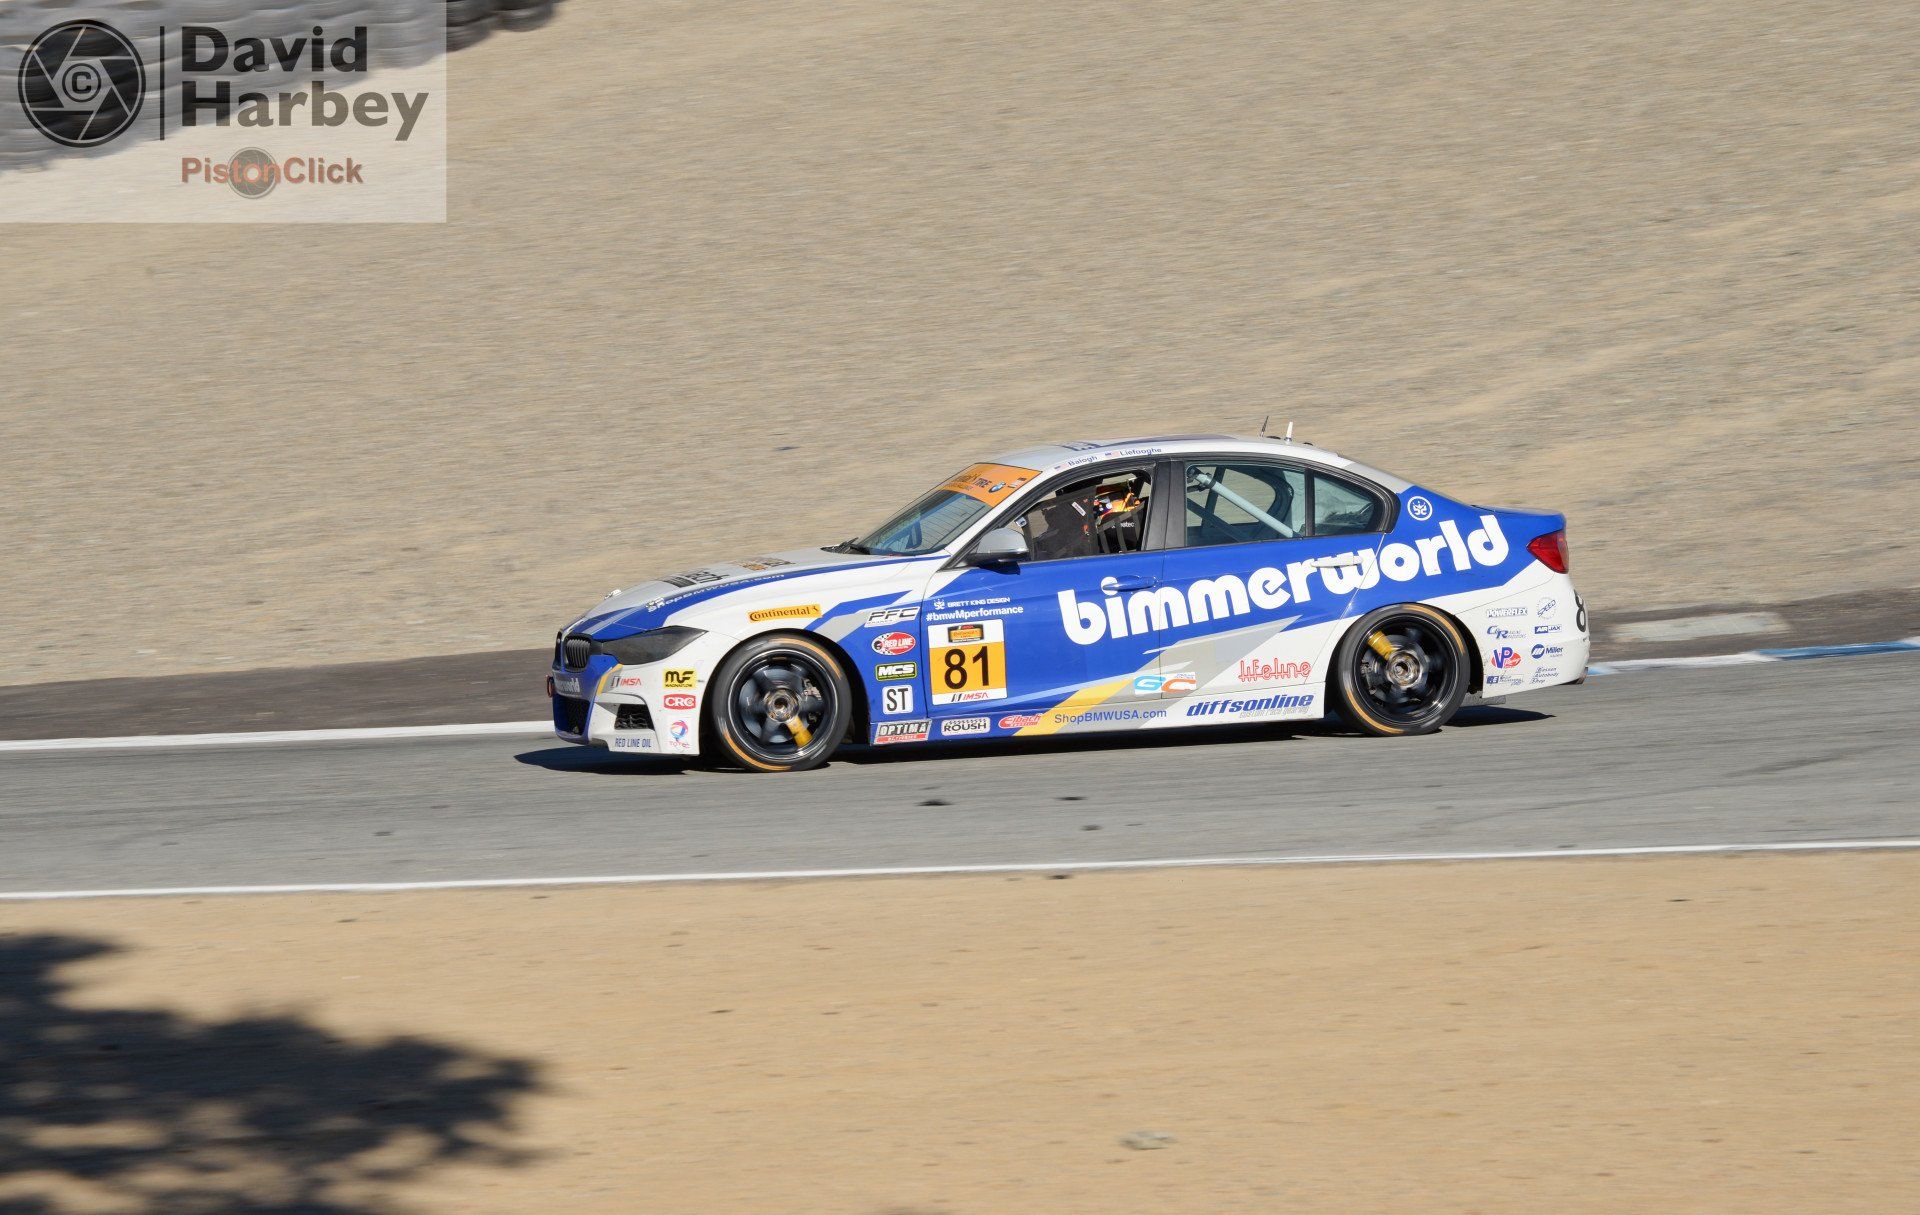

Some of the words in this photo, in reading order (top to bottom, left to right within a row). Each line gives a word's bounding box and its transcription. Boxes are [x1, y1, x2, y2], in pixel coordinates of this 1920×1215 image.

[1068, 456, 1098, 467] Balogh
[1058, 515, 1510, 645] bimmerworld
[749, 607, 811, 622] Continental
[869, 607, 918, 622] PFC
[926, 605, 1024, 622] #bmwMperformance
[1487, 607, 1528, 617] POWERFLEX
[898, 637, 913, 647] LINE
[1546, 646, 1563, 654] Miller
[1493, 647, 1513, 669] VP
[878, 664, 915, 677] MCS
[944, 646, 989, 689] 81
[620, 676, 642, 687] IMSA
[665, 697, 694, 707] CRC
[886, 687, 909, 711] ST
[963, 693, 989, 701] IMSA
[1187, 694, 1314, 717] diffsonline
[1054, 708, 1167, 725] ShopBMWUSA.com
[879, 722, 928, 736] OPTIMA
[944, 723, 986, 732] ROUSH
[615, 738, 625, 748] RED
[627, 738, 640, 748] LINE
[642, 738, 652, 748] OIL
